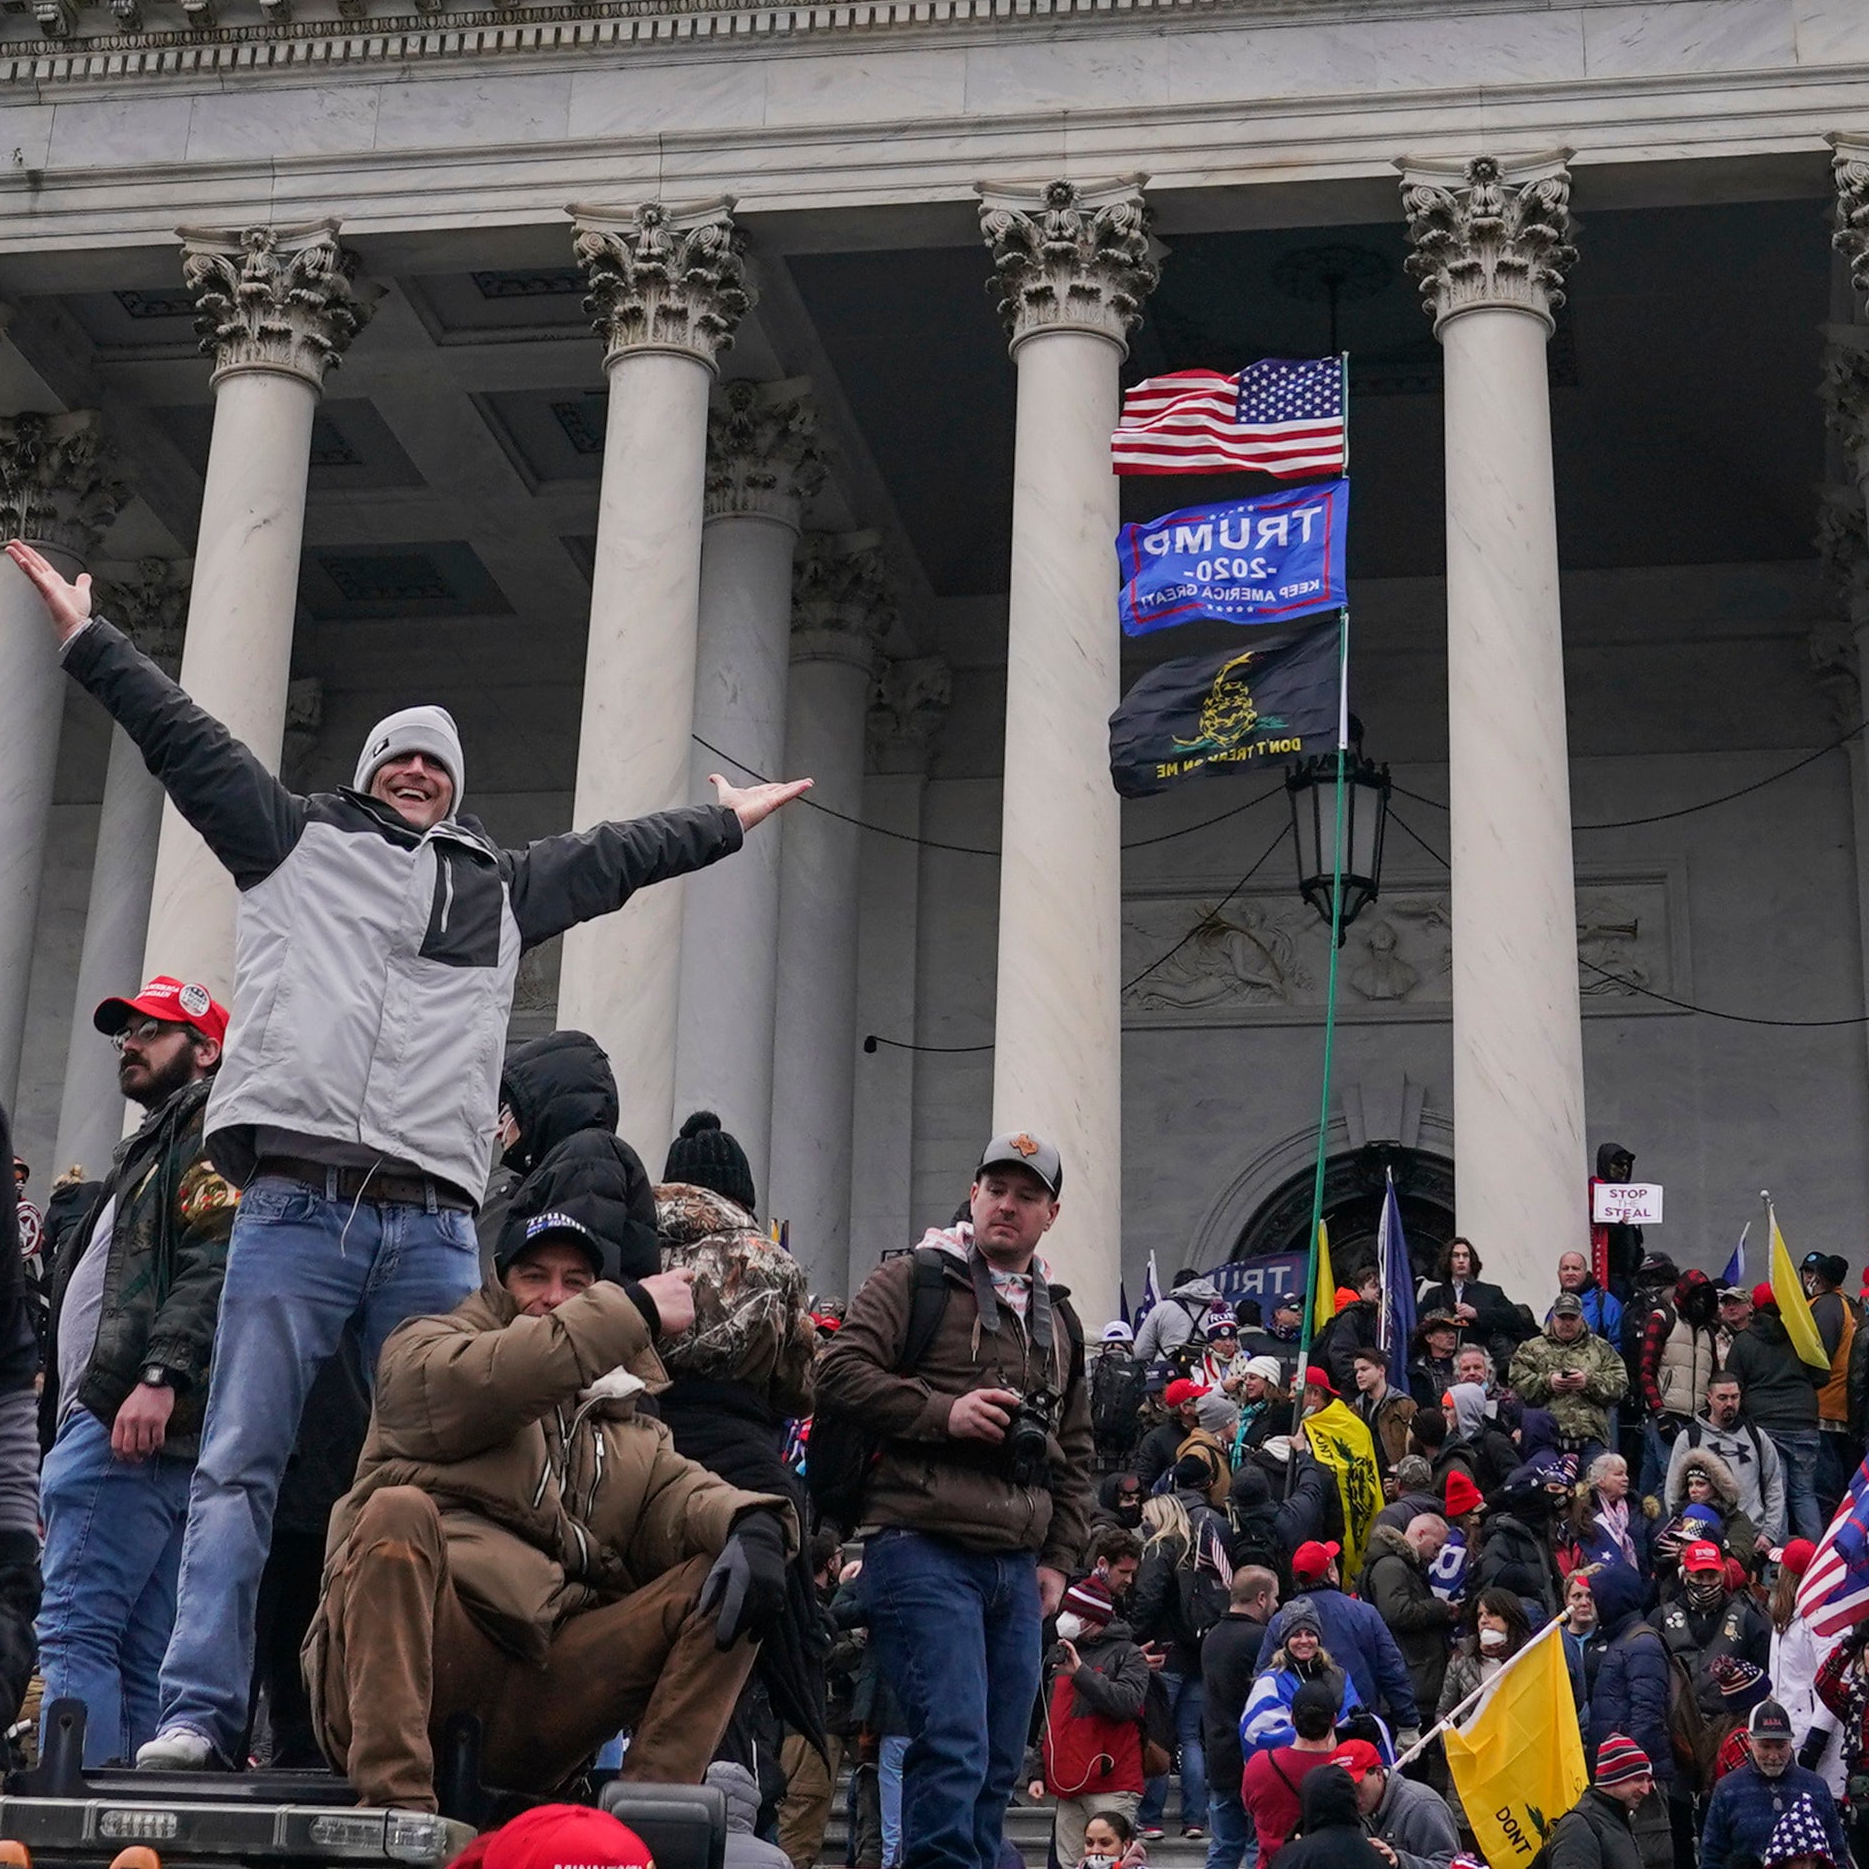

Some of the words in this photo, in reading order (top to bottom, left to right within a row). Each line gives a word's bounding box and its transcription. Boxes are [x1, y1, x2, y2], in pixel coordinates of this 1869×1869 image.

[1609, 1189, 1648, 1199] STOP
[1617, 1199, 1639, 1208] THE
[1605, 1207, 1652, 1219] STEAL
[1495, 1806, 1532, 1854] DONT
